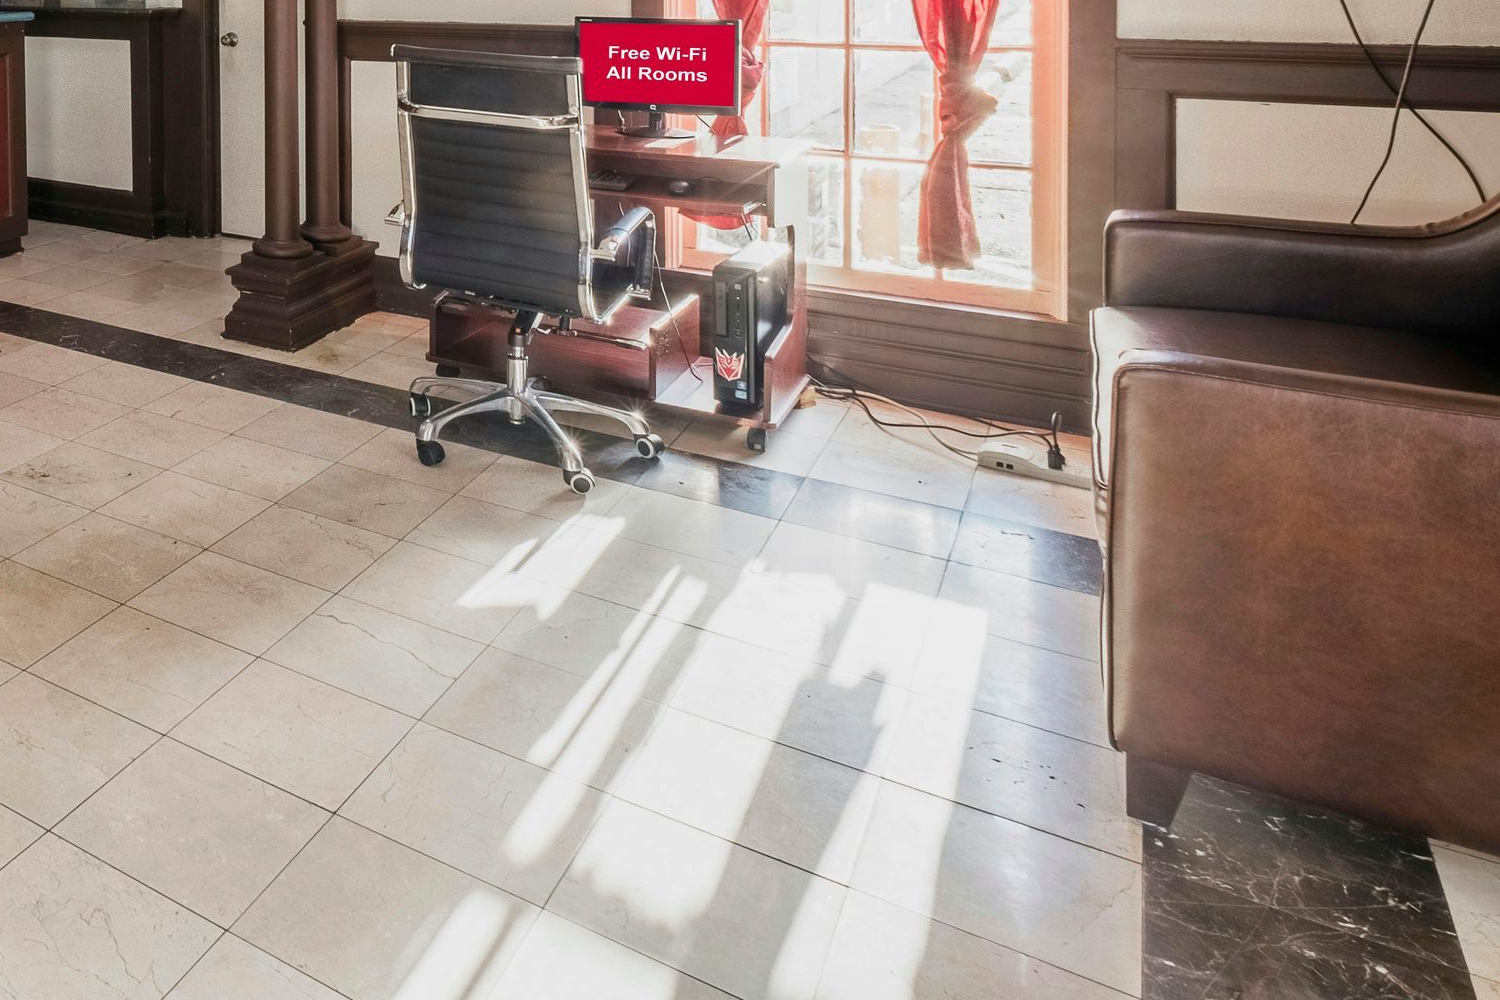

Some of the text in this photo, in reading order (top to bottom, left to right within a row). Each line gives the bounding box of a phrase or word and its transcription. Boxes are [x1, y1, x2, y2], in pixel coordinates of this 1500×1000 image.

[608, 45, 707, 62] Free Wi-Fi
[606, 65, 708, 83] All Rooms
